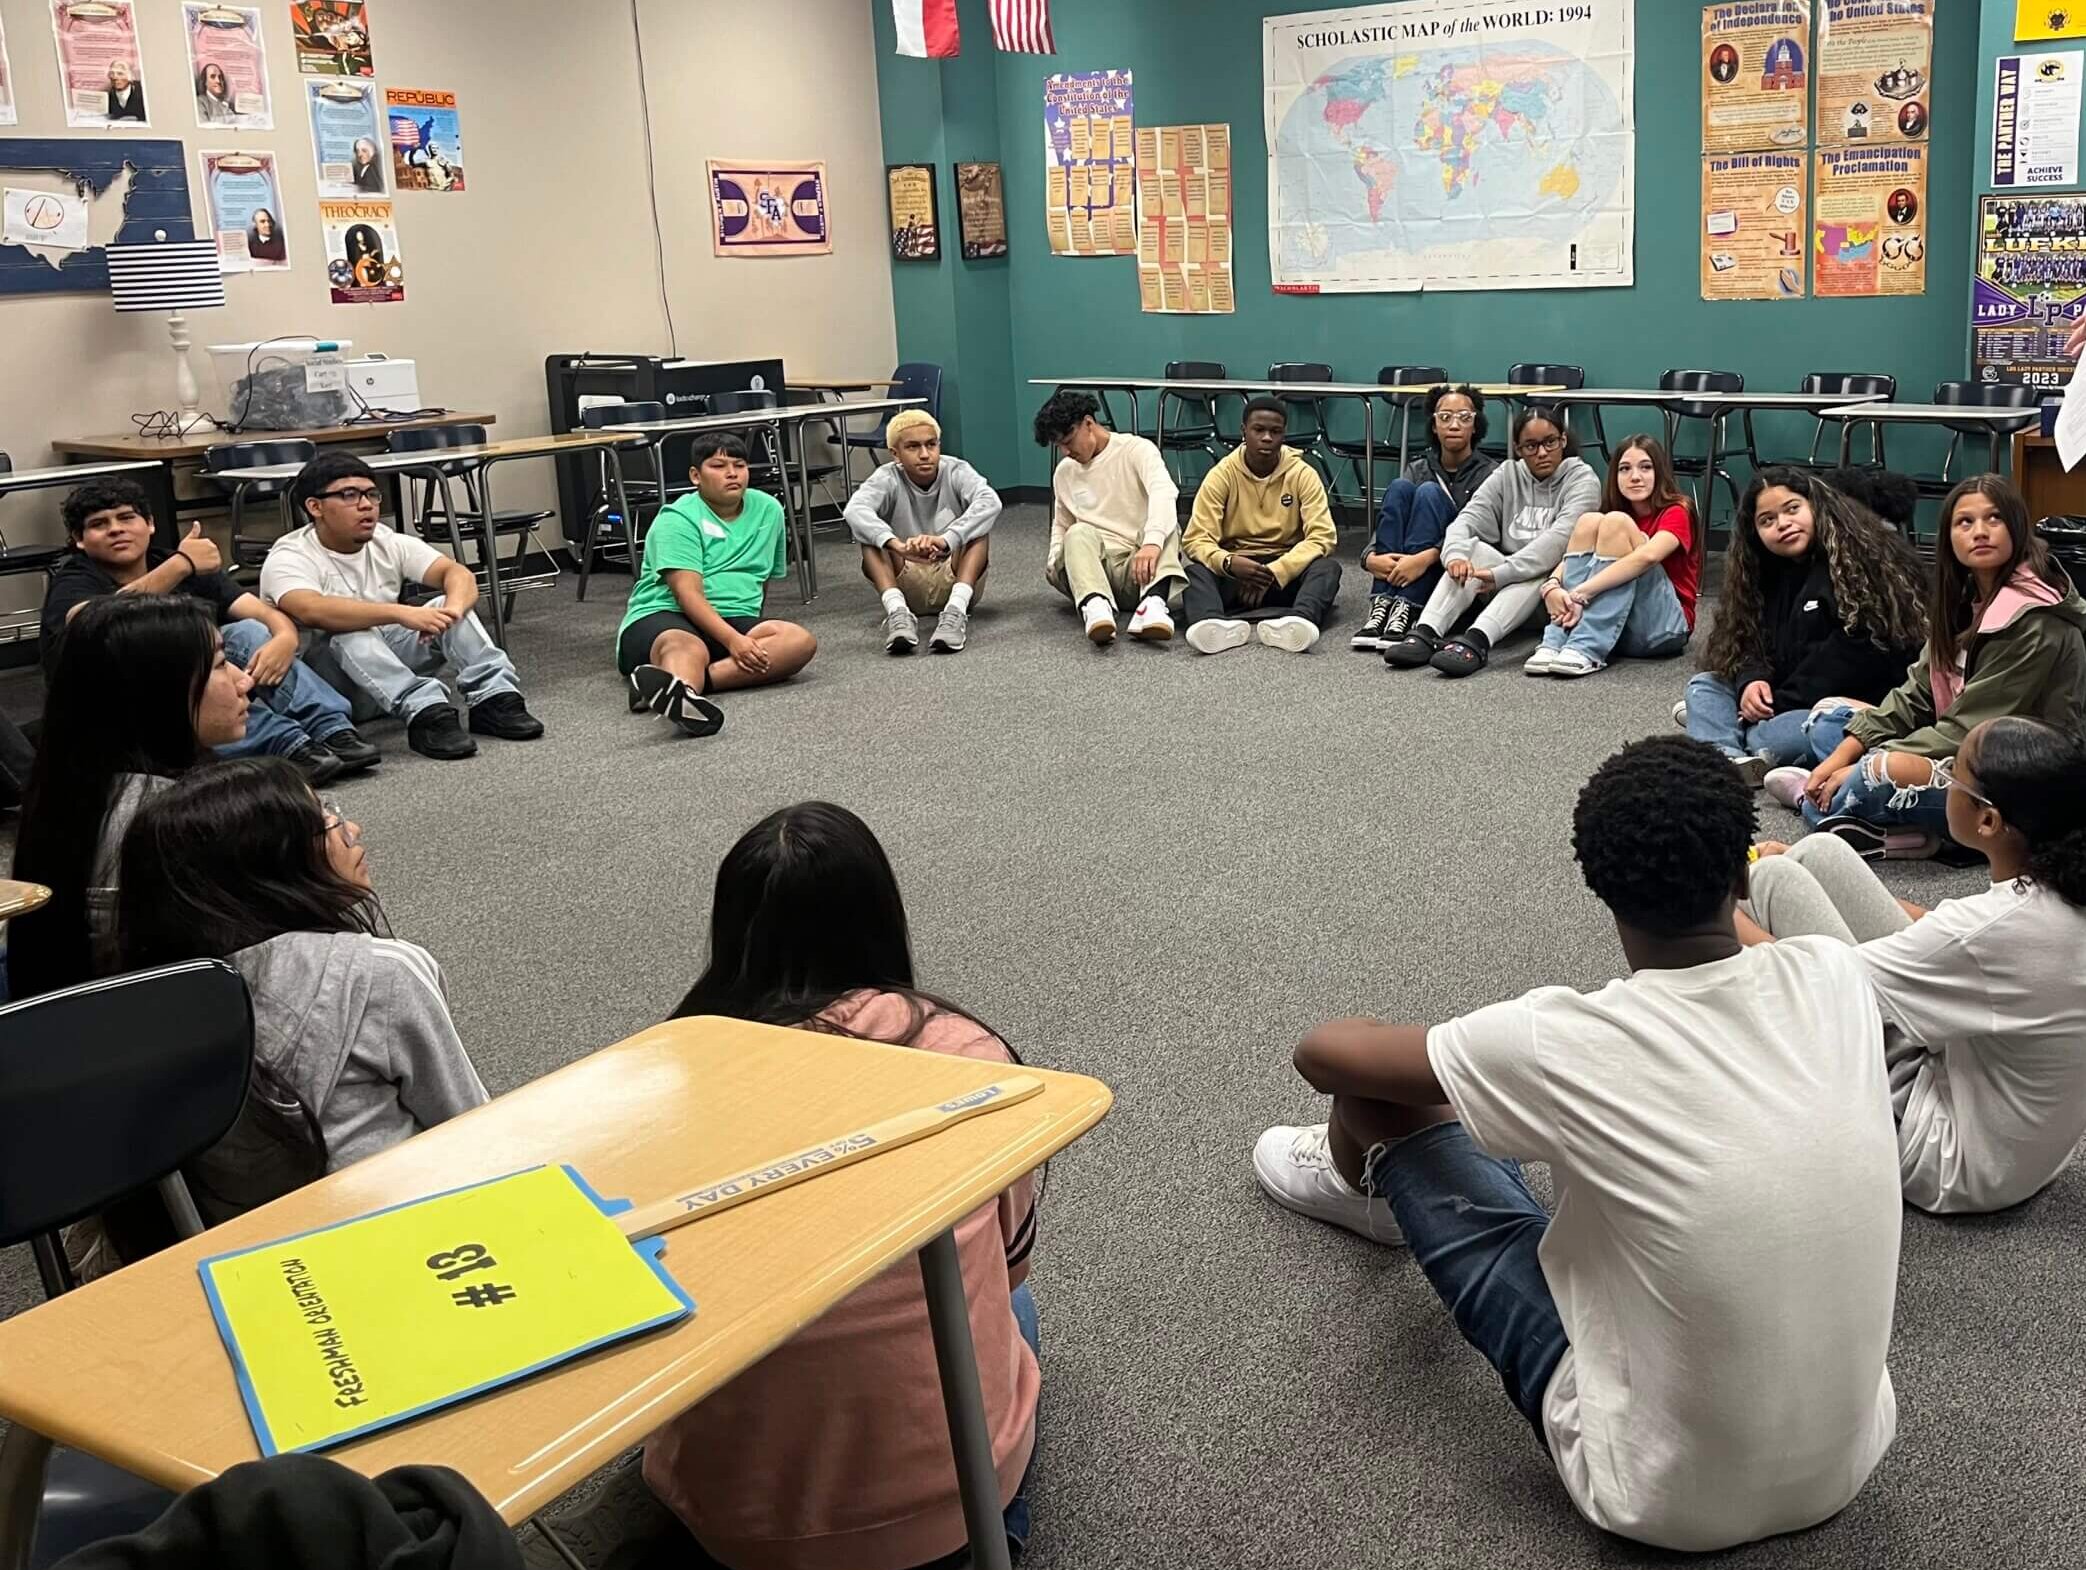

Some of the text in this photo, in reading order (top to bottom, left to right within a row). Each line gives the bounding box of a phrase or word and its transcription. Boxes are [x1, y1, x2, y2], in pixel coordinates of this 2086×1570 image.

[1713, 2, 1799, 20] The Declaraion
[1846, 4, 1883, 18] United
[1297, 4, 1592, 50] SCHOLASTIC MAP of the WORLD: 1994
[1710, 13, 1802, 32] of Independence
[1047, 76, 1128, 90] Amendments to the
[386, 90, 456, 106] REPUBLIC
[1047, 89, 1129, 103] Constitution of the
[1060, 103, 1117, 115] United States
[1997, 70, 2016, 175] THE PANTHER WAY
[1711, 155, 1800, 172] The Bill of Rights
[1821, 146, 1921, 166] The Emancipation
[1832, 159, 1908, 176] Proclamation
[2027, 166, 2063, 174] ACHIEVE
[2027, 174, 2063, 182] SUCCESS
[322, 205, 391, 220] THEOCRACY
[1978, 304, 2017, 317] LADY
[2027, 294, 2063, 326] LP
[2022, 372, 2059, 384] 2023
[834, 1134, 877, 1154] 5%
[749, 1150, 835, 1187] EVERY
[686, 1183, 743, 1211] DAY
[280, 1258, 368, 1408] FRESHMAN ORIENTATION
